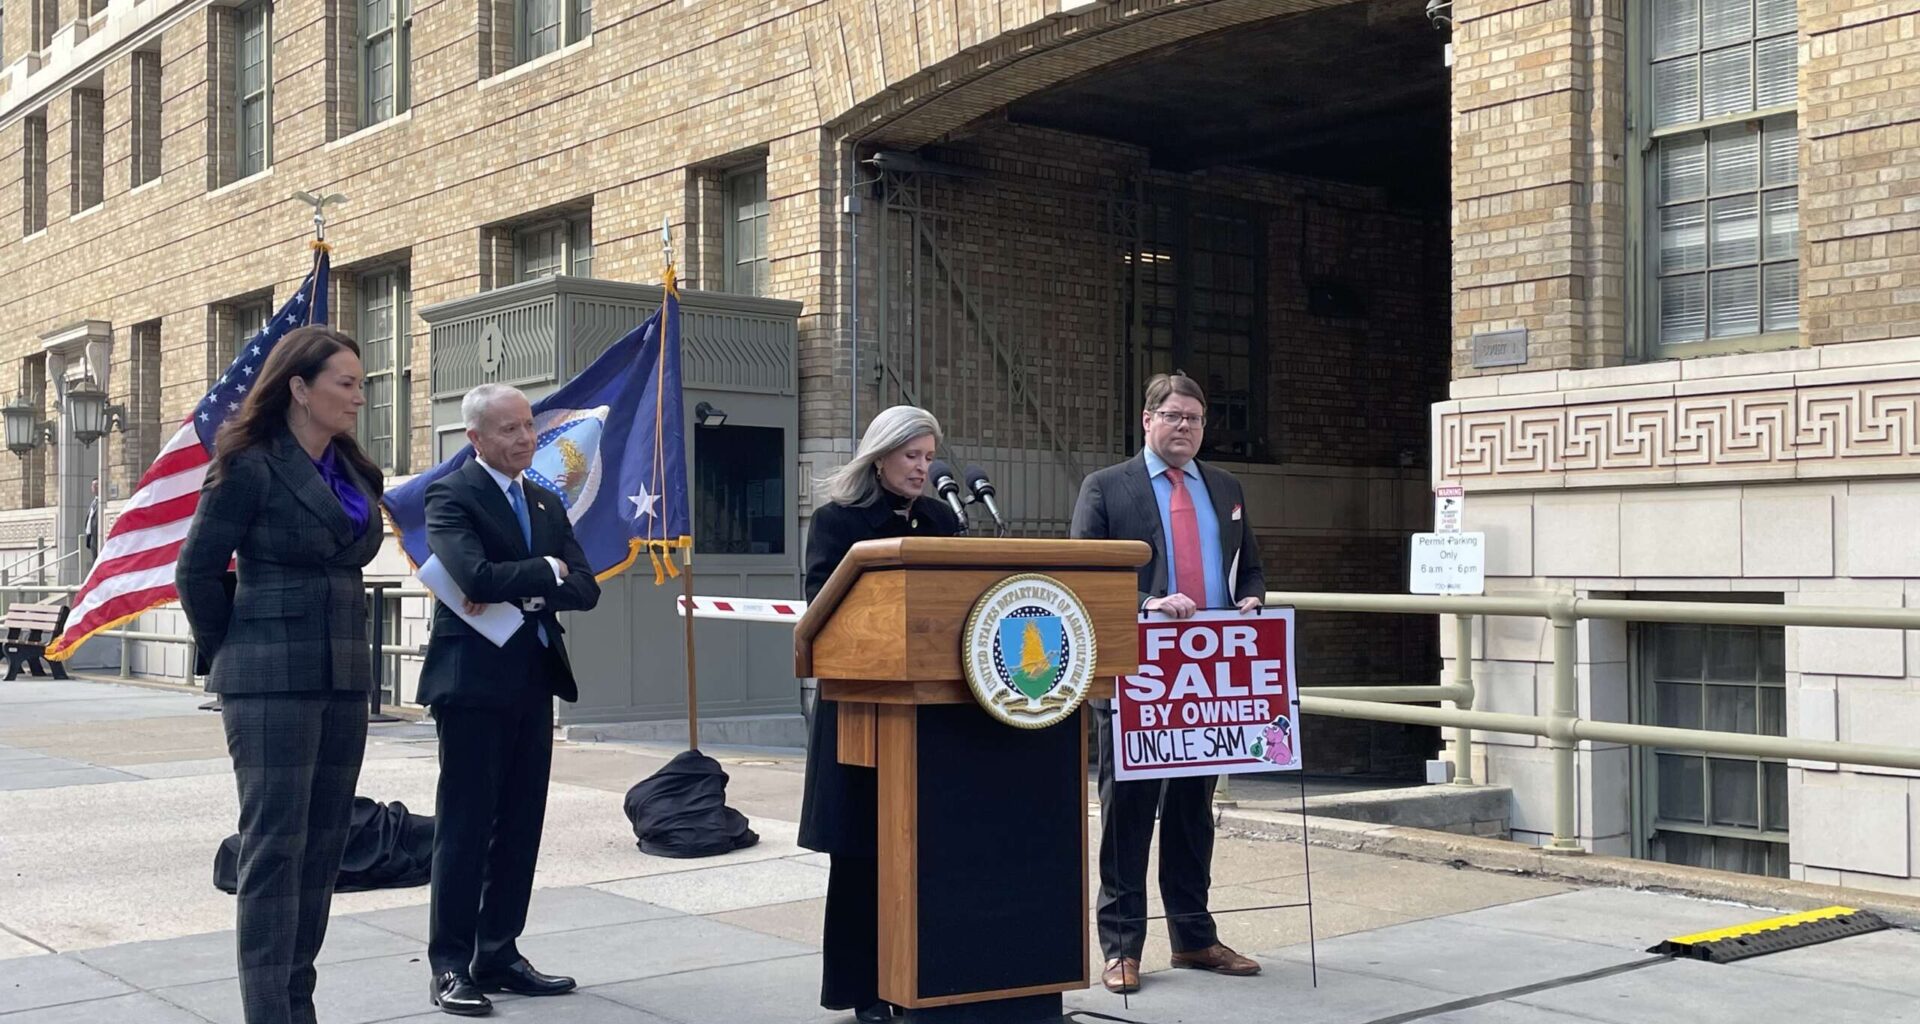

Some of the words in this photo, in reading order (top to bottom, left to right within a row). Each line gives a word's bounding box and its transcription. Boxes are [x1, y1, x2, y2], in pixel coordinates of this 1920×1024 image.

[487, 333, 493, 362] 1
[1438, 488, 1462, 497] WARNING
[1419, 537, 1445, 545] Permit
[1448, 536, 1478, 547] Parking
[1439, 550, 1458, 560] Only
[996, 586, 1059, 611] DEPARTMENT
[1057, 598, 1072, 614] OF
[978, 607, 1000, 647] STATES
[1066, 611, 1087, 688] AGRICULTURE
[1146, 625, 1258, 661] FOR
[977, 650, 998, 692] UNITED
[1125, 659, 1282, 702] SALE
[1139, 703, 1173, 727] BY
[1182, 698, 1271, 725] OWNER
[1127, 728, 1198, 764] UNCLE
[1203, 726, 1248, 758] SAM
